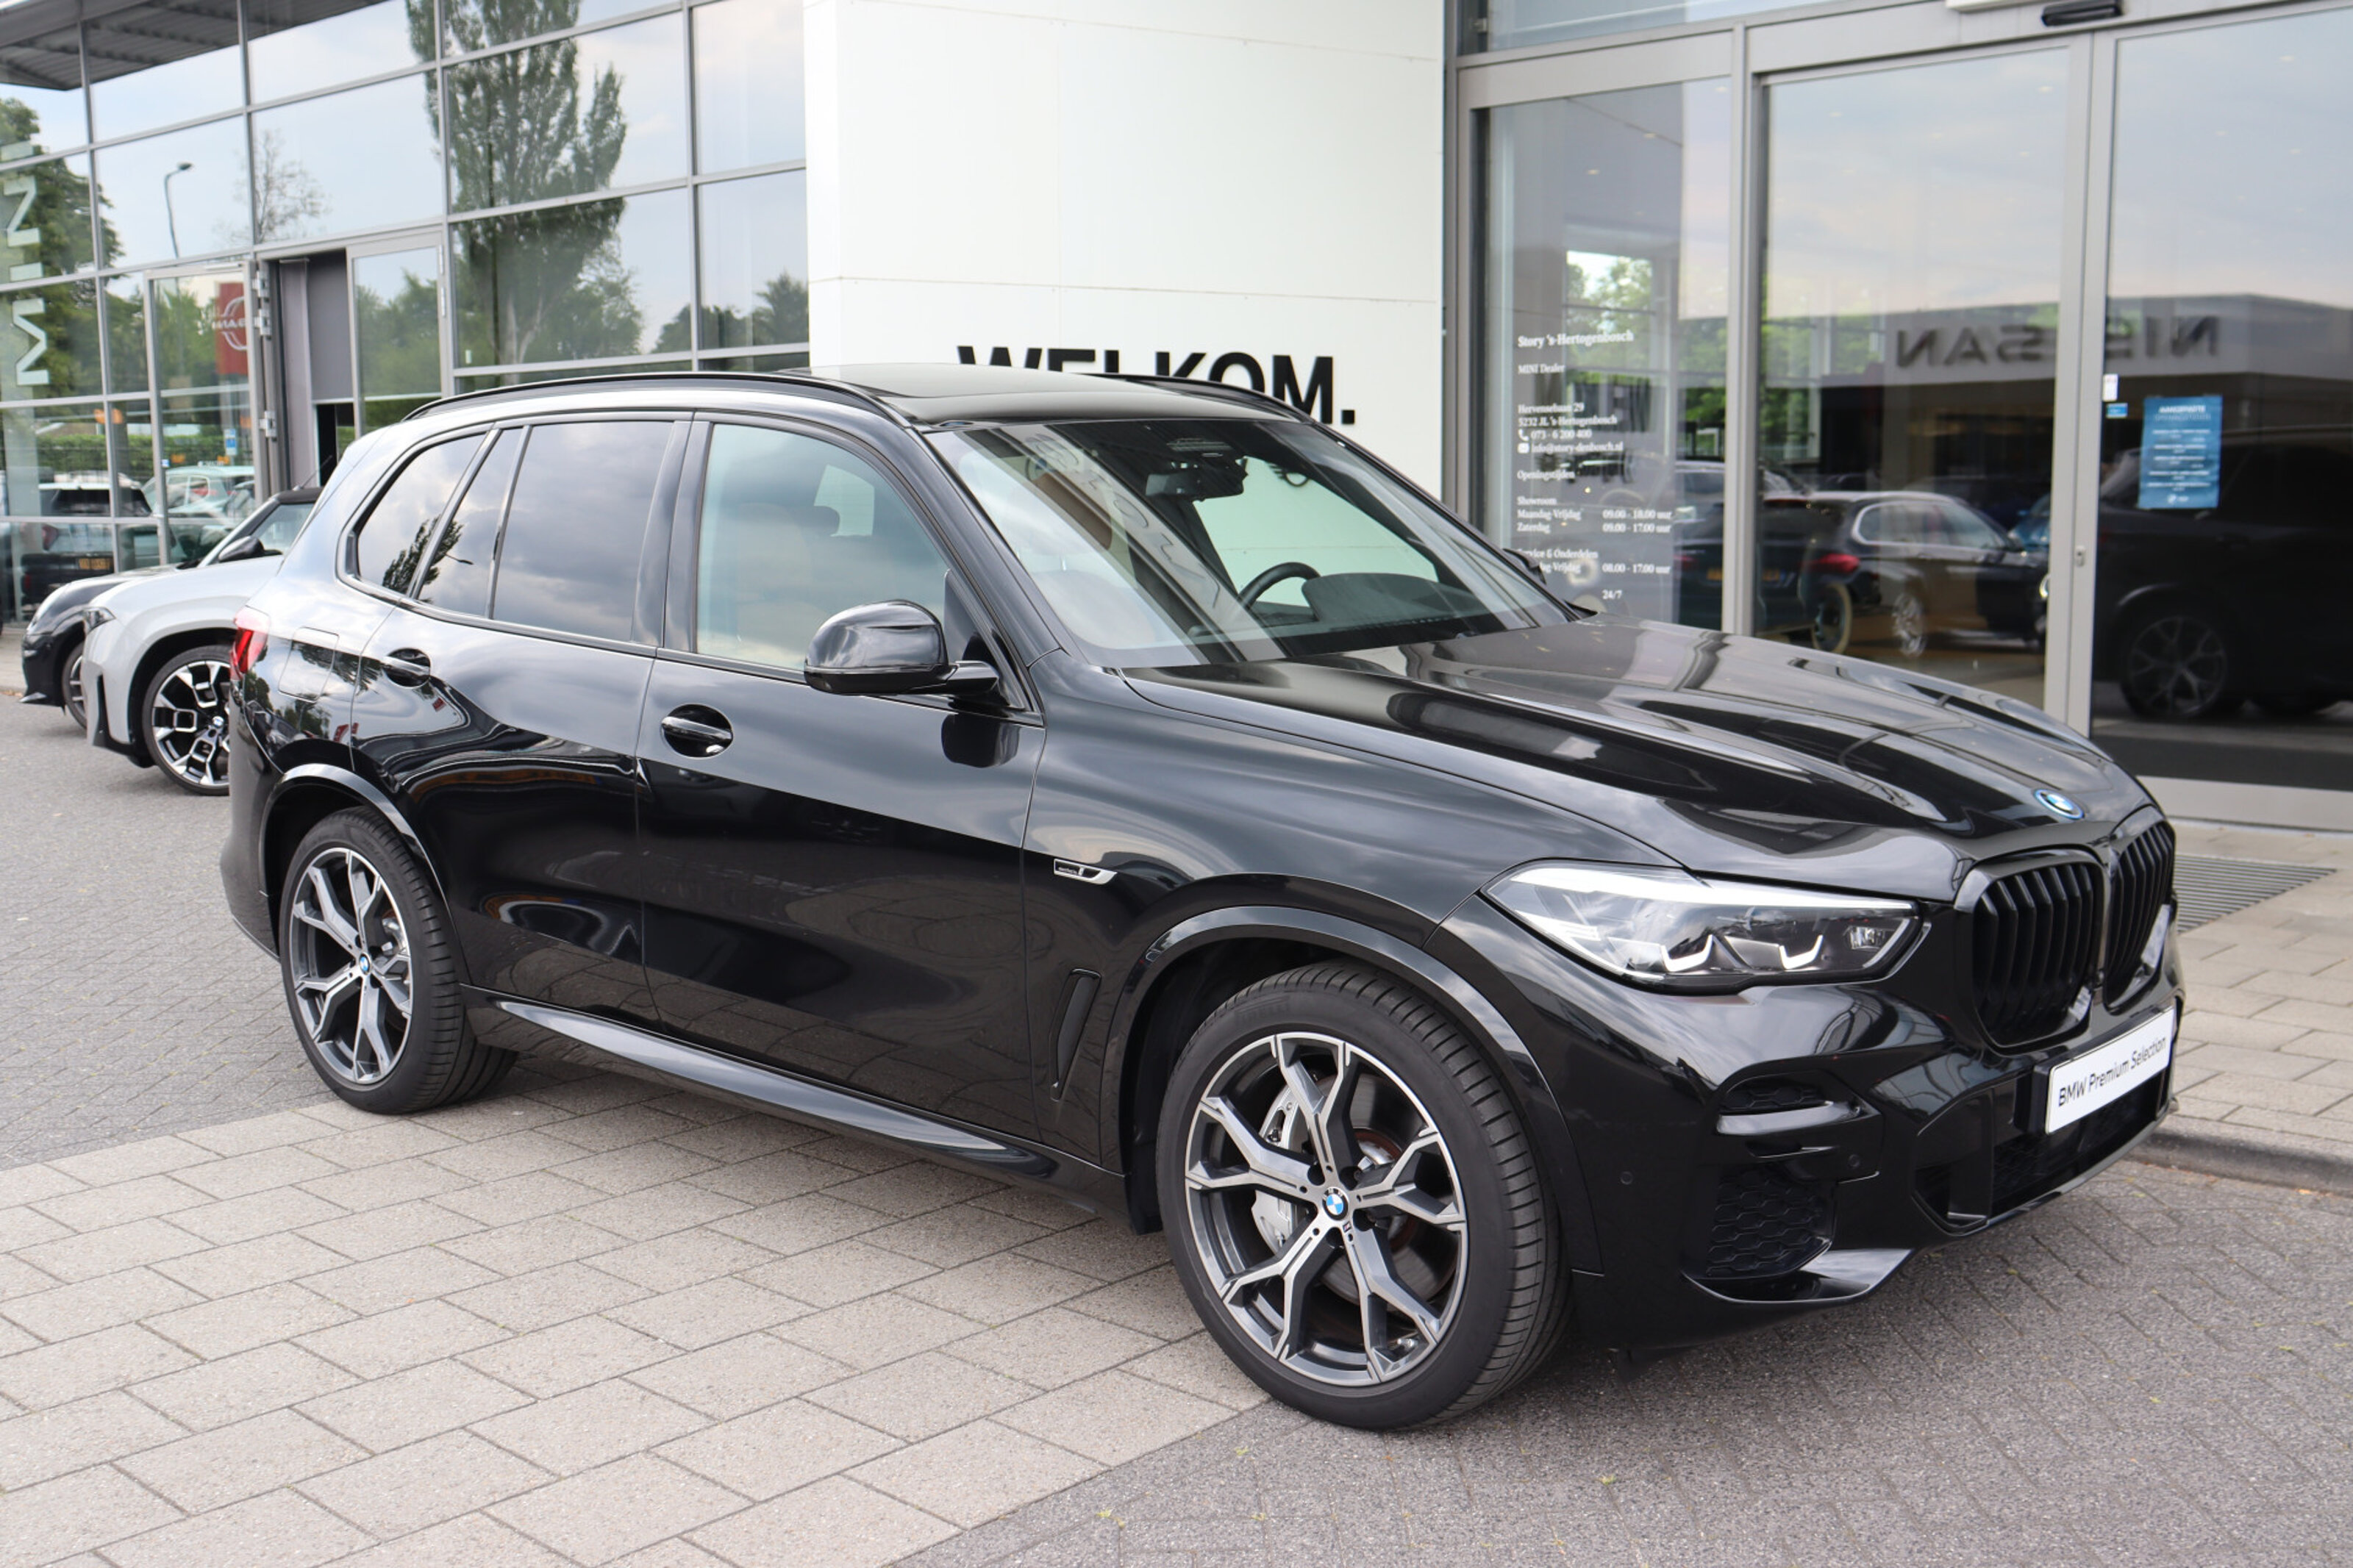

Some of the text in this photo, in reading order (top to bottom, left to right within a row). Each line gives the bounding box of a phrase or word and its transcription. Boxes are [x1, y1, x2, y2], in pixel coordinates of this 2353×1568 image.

[1, 140, 50, 386] MINI
[1518, 335, 1544, 349] Story
[1518, 362, 1565, 374] MINI Dealer
[1574, 402, 1585, 412] 29
[1517, 470, 1576, 481] Openingstijden
[1517, 496, 1557, 506] Showroom
[1657, 511, 1672, 520] uur
[1517, 523, 1551, 534] Zaterdag
[1632, 523, 1655, 533] 17.00
[1655, 524, 1671, 534] uur
[1553, 548, 1599, 559] Onderdelen
[1632, 563, 1655, 573] 17.00
[1655, 565, 1671, 574] uur
[1602, 590, 1622, 600] 24/7
[2058, 1037, 2165, 1107] BMW Premium Selection
